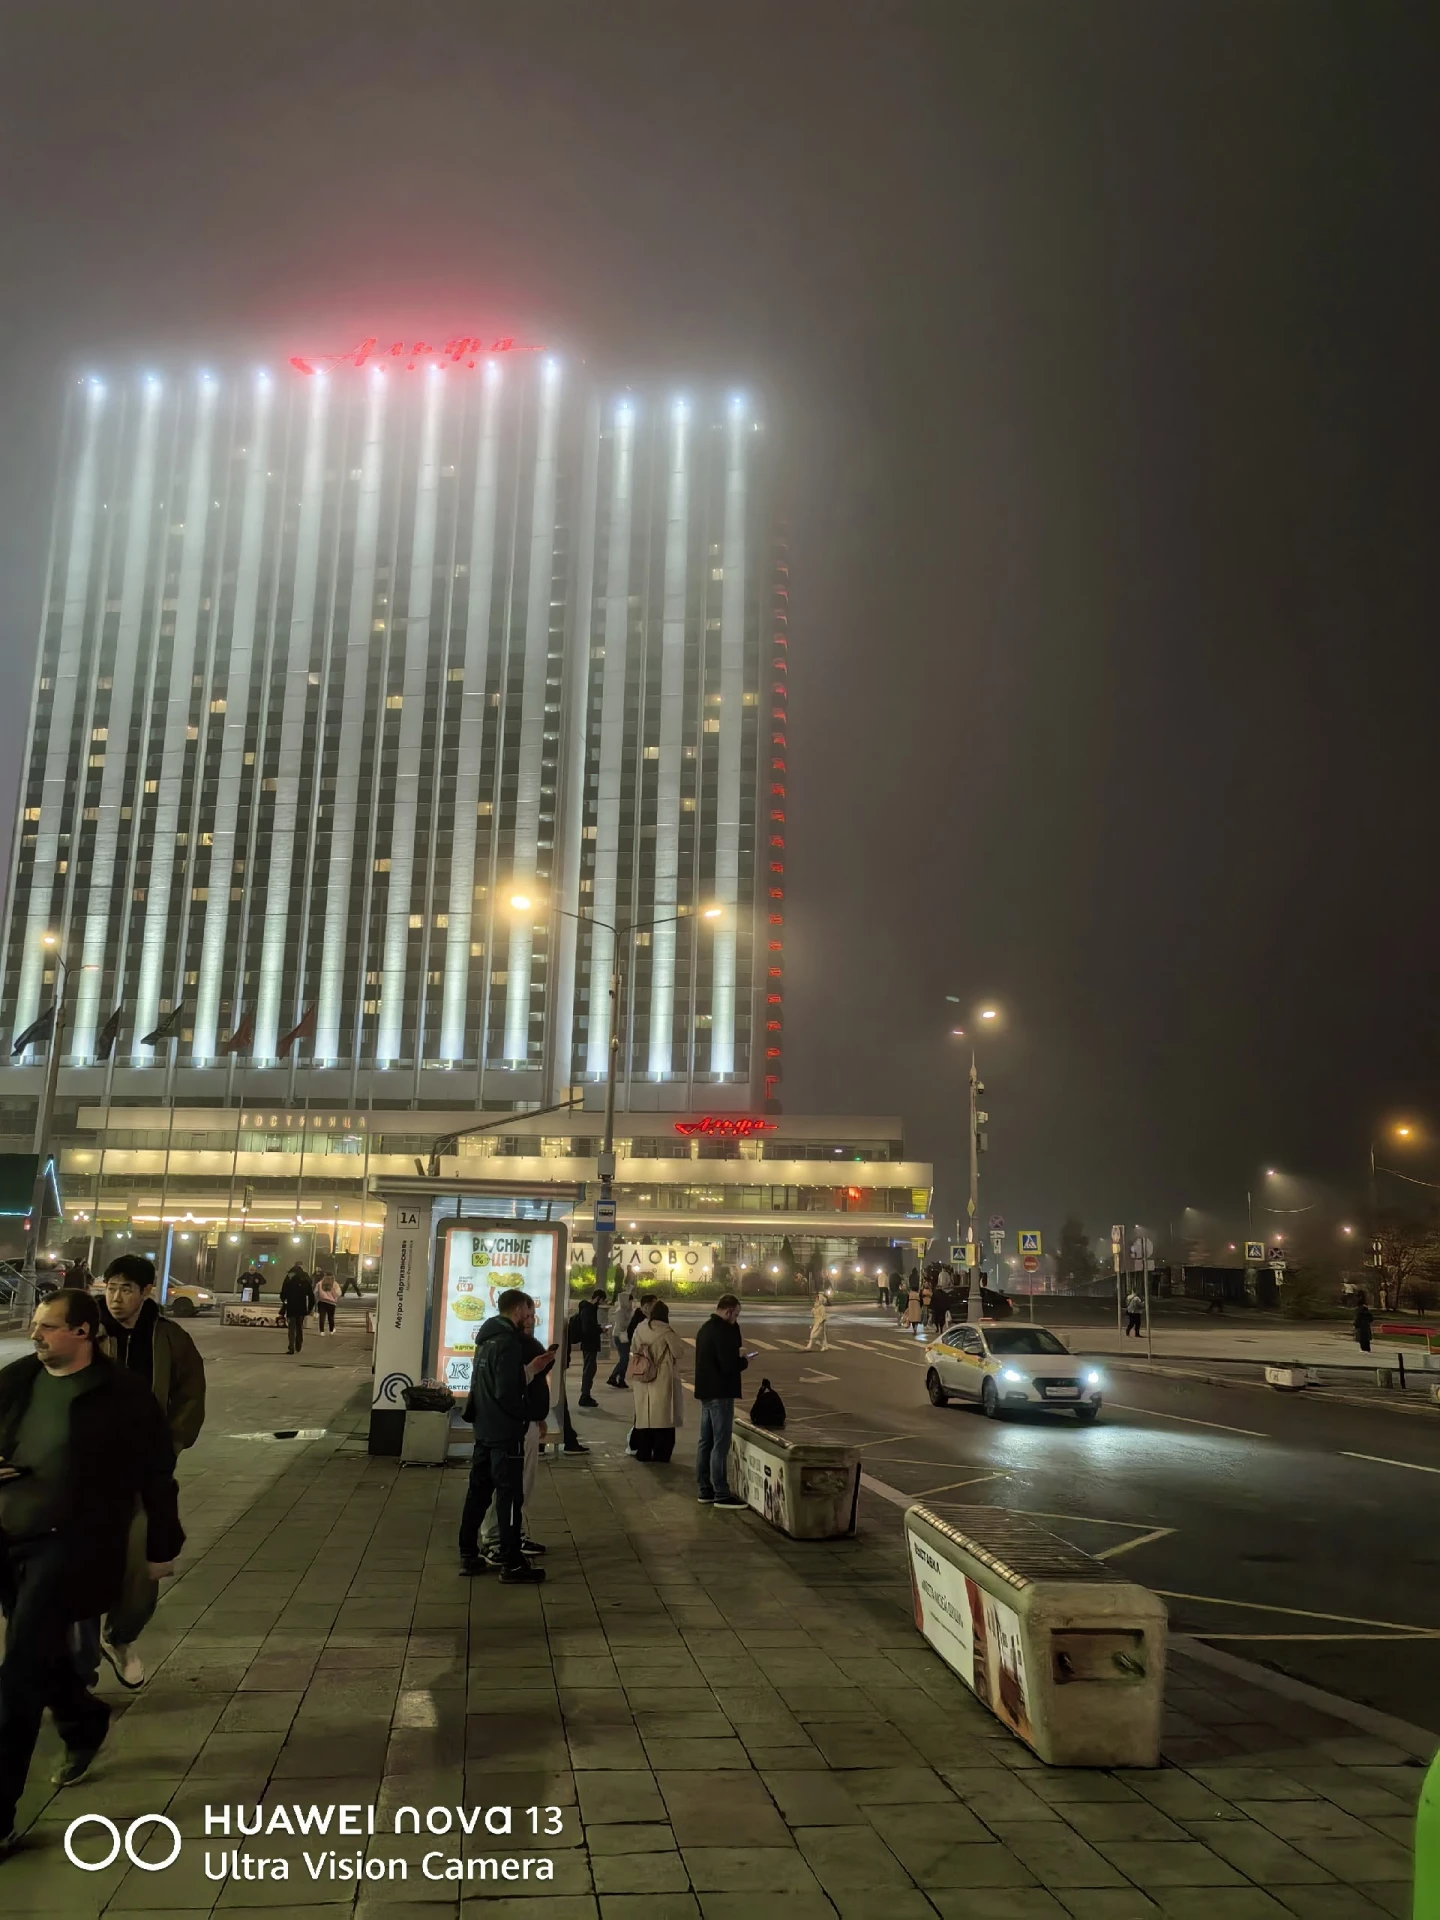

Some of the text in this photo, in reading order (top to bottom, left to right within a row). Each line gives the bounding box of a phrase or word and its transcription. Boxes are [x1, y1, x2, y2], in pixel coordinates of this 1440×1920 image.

[240, 1114, 367, 1129] ГОСТИНИЦА
[674, 1116, 779, 1136] Альфа
[491, 1253, 529, 1267] ЦЕНЫ
[394, 1302, 404, 1329] Метро
